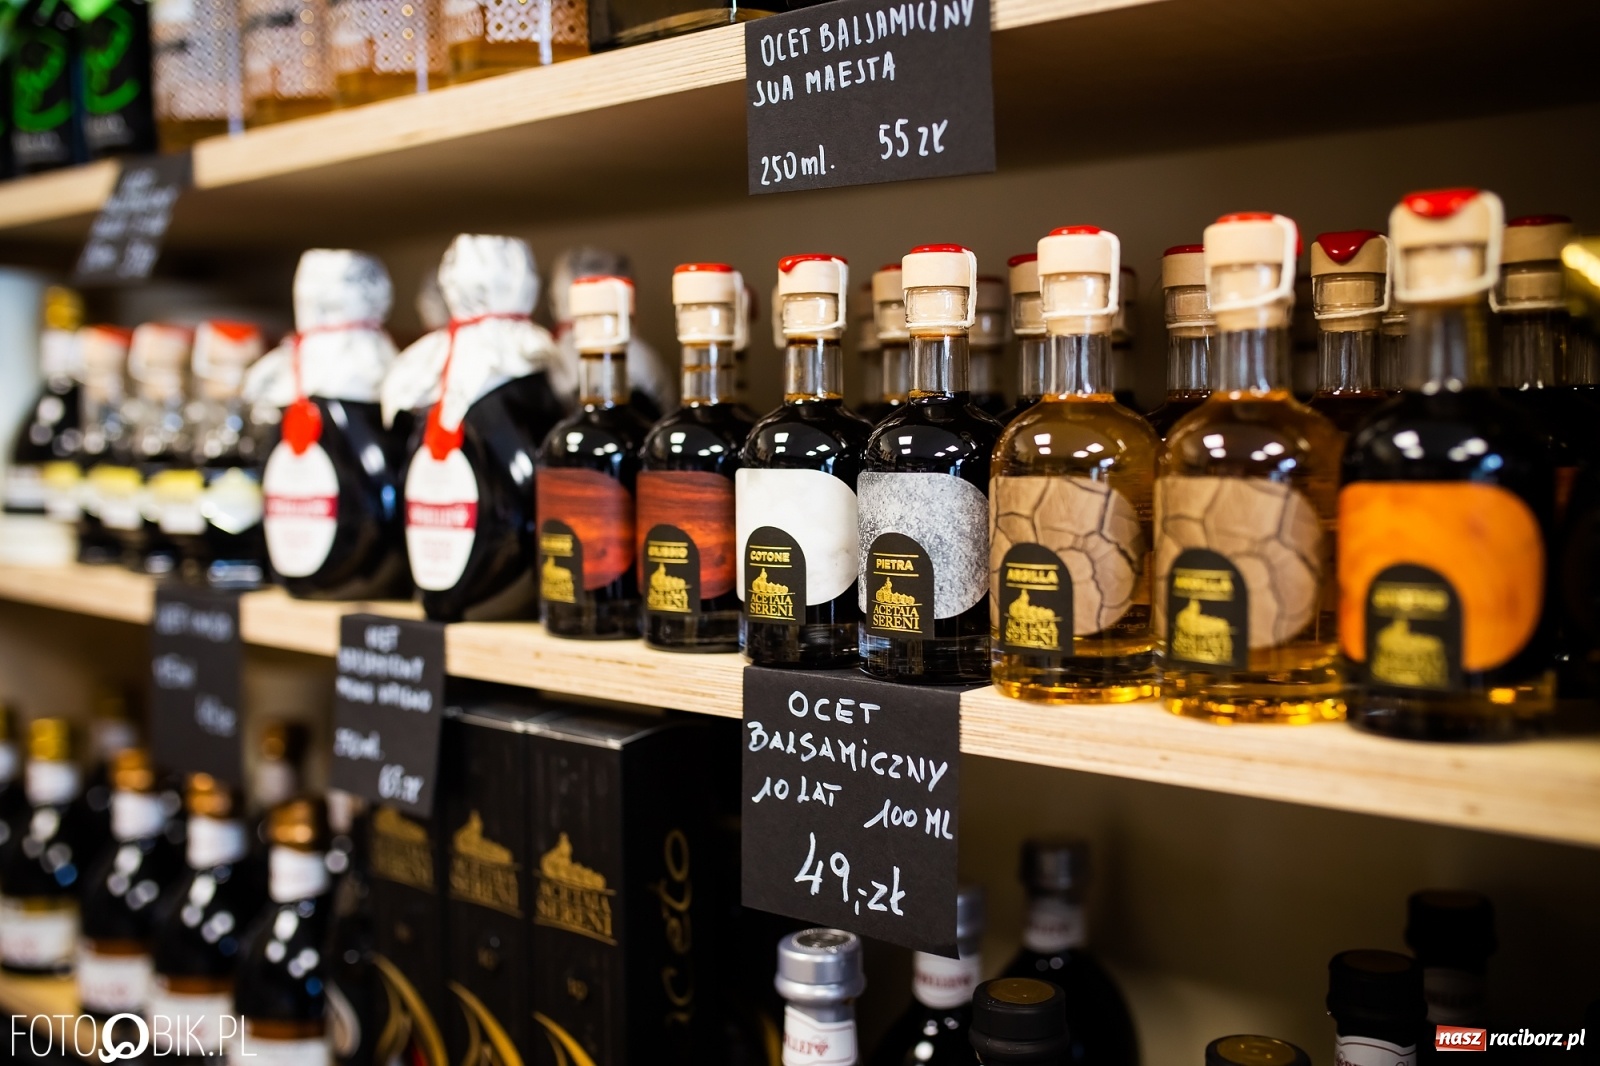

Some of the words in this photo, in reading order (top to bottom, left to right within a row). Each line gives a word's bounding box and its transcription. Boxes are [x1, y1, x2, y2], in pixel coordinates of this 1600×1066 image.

[761, 27, 811, 66] OCET
[820, 0, 975, 52] BALSAMICZNY
[753, 74, 794, 107] SUA
[806, 51, 896, 94] MAESTA
[750, 551, 790, 562] COTONE
[876, 558, 914, 571] PIETRA
[750, 603, 793, 617] SERENI
[751, 593, 792, 605] ACETAIA
[873, 604, 918, 617] ACETAIA
[872, 614, 919, 630] SERENI
[788, 690, 881, 724] OCET
[747, 721, 949, 792] BALSAMICZNY
[752, 776, 790, 804] 10
[797, 775, 843, 807] LAT
[863, 798, 918, 828] 100
